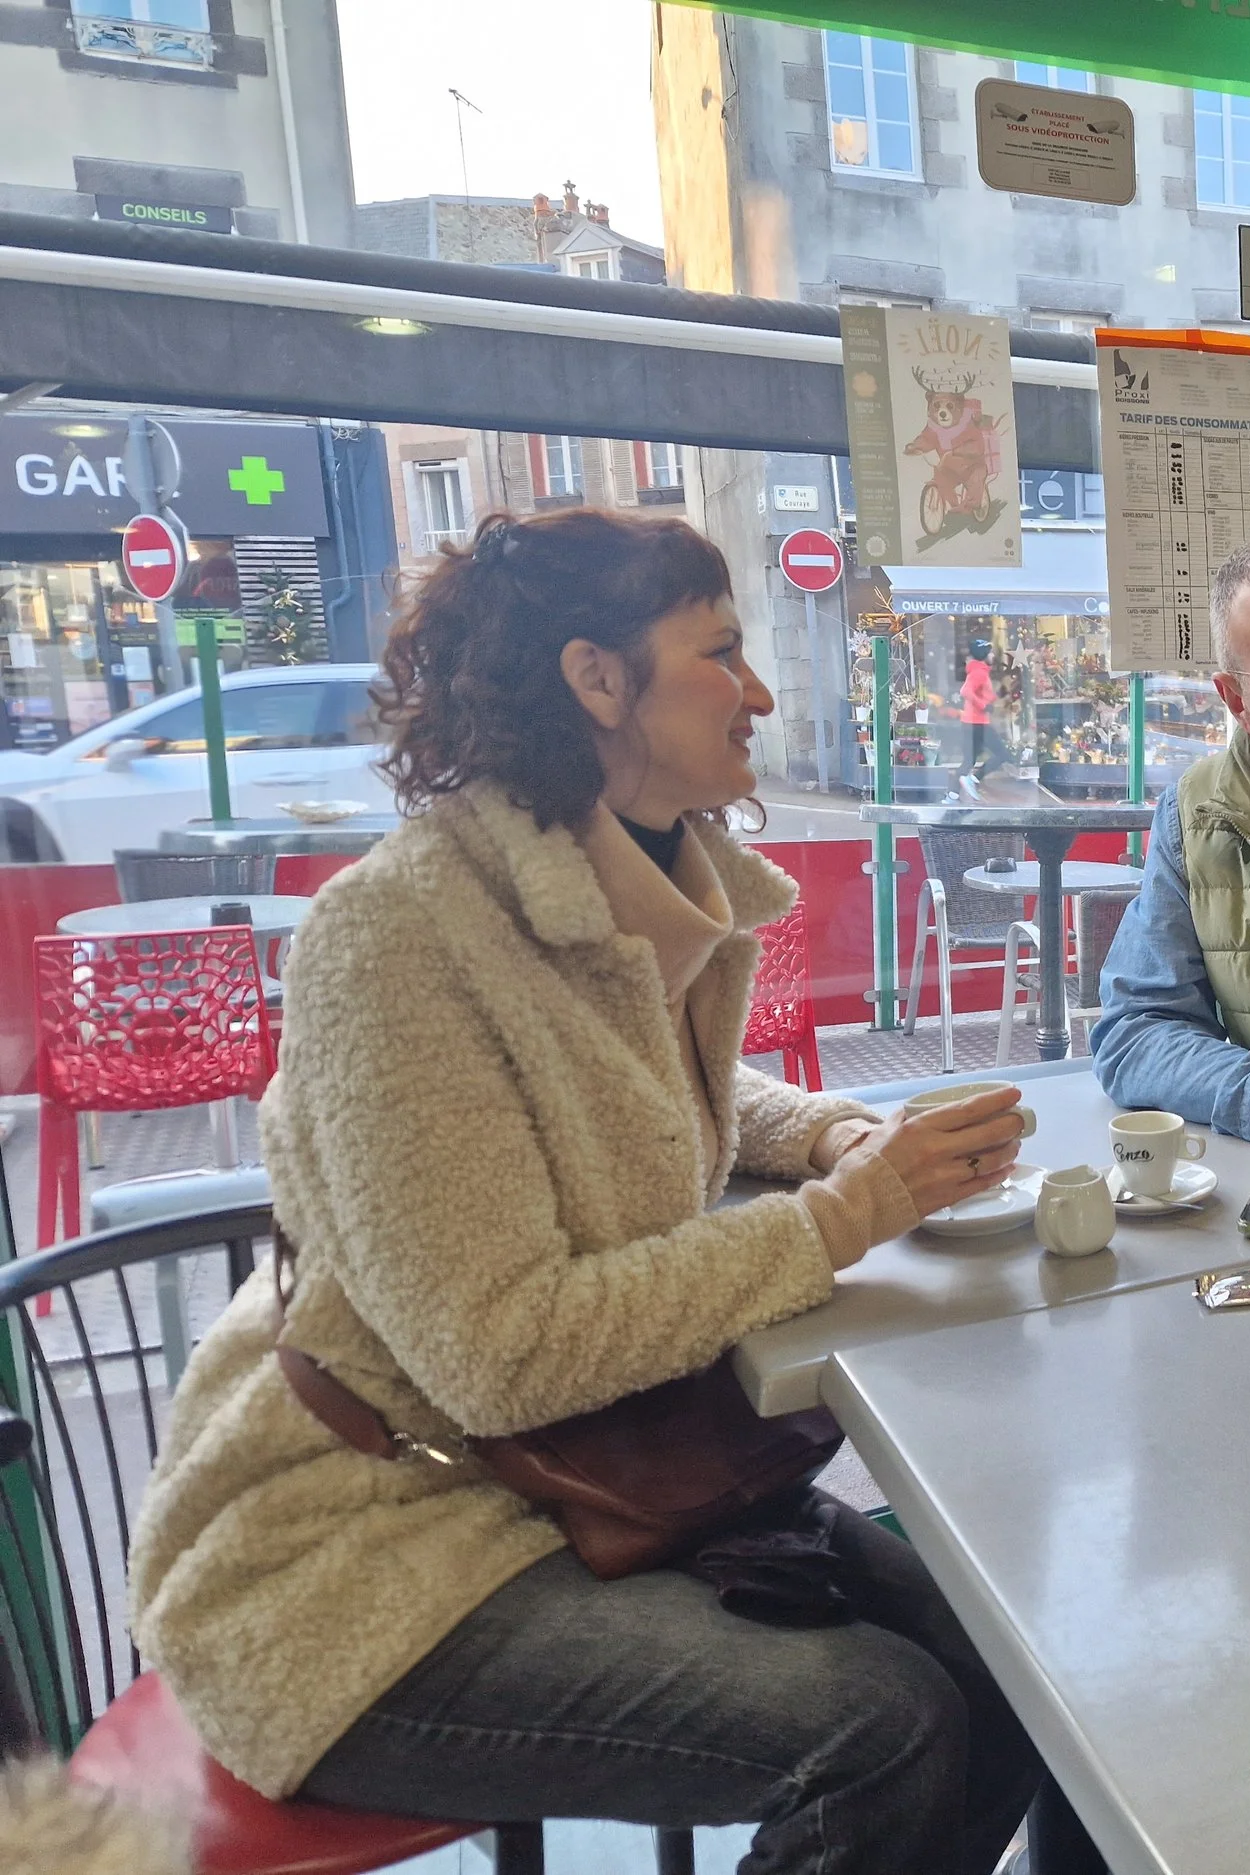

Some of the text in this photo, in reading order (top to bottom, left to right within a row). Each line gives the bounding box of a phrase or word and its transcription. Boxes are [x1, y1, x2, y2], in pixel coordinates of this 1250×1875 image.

[1031, 107, 1085, 122] ÉTABLISSEMENT
[1049, 120, 1070, 129] PLACÉ
[1006, 123, 1110, 145] SOUS VIDÉOPROTECTION
[122, 203, 207, 225] CONSEILS
[1115, 389, 1150, 398] Proxi
[1120, 412, 1153, 424] TARIF
[1155, 416, 1178, 426] DES
[15, 454, 181, 498] GAR
[794, 490, 806, 498] Rue
[784, 500, 810, 508] Couraye
[902, 600, 999, 613] OUVERT 7 jours/7
